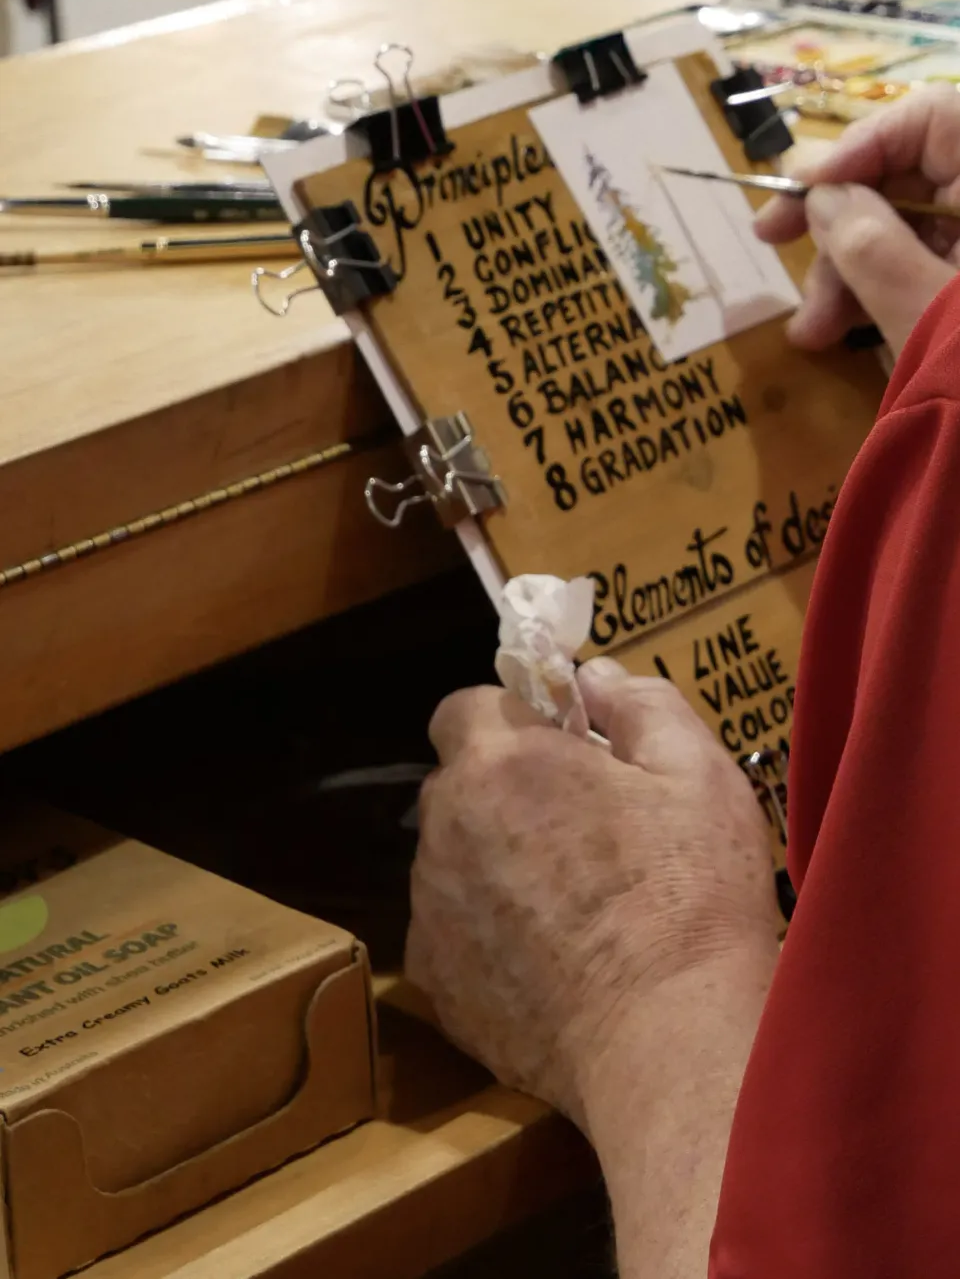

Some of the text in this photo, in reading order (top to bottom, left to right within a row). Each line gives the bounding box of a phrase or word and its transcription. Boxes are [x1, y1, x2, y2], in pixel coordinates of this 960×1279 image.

[425, 192, 555, 262] 1 UNITY
[437, 263, 464, 300] 2
[453, 293, 476, 329] 3
[467, 327, 492, 357] 4
[487, 358, 515, 394] 5
[508, 390, 534, 429] 6
[523, 358, 720, 465] 7 HARMONY
[546, 395, 748, 511] 8 GRADATION
[587, 526, 734, 646] Elements
[745, 500, 773, 570] of
[693, 614, 760, 680] LINE
[700, 648, 788, 714] VALUE
[53, 961, 111, 986] OIL
[102, 922, 179, 964] SOAP
[18, 1029, 79, 1058] Extra
[81, 995, 152, 1030] Creamy
[153, 968, 208, 996] Goats
[209, 947, 251, 969] Milk
